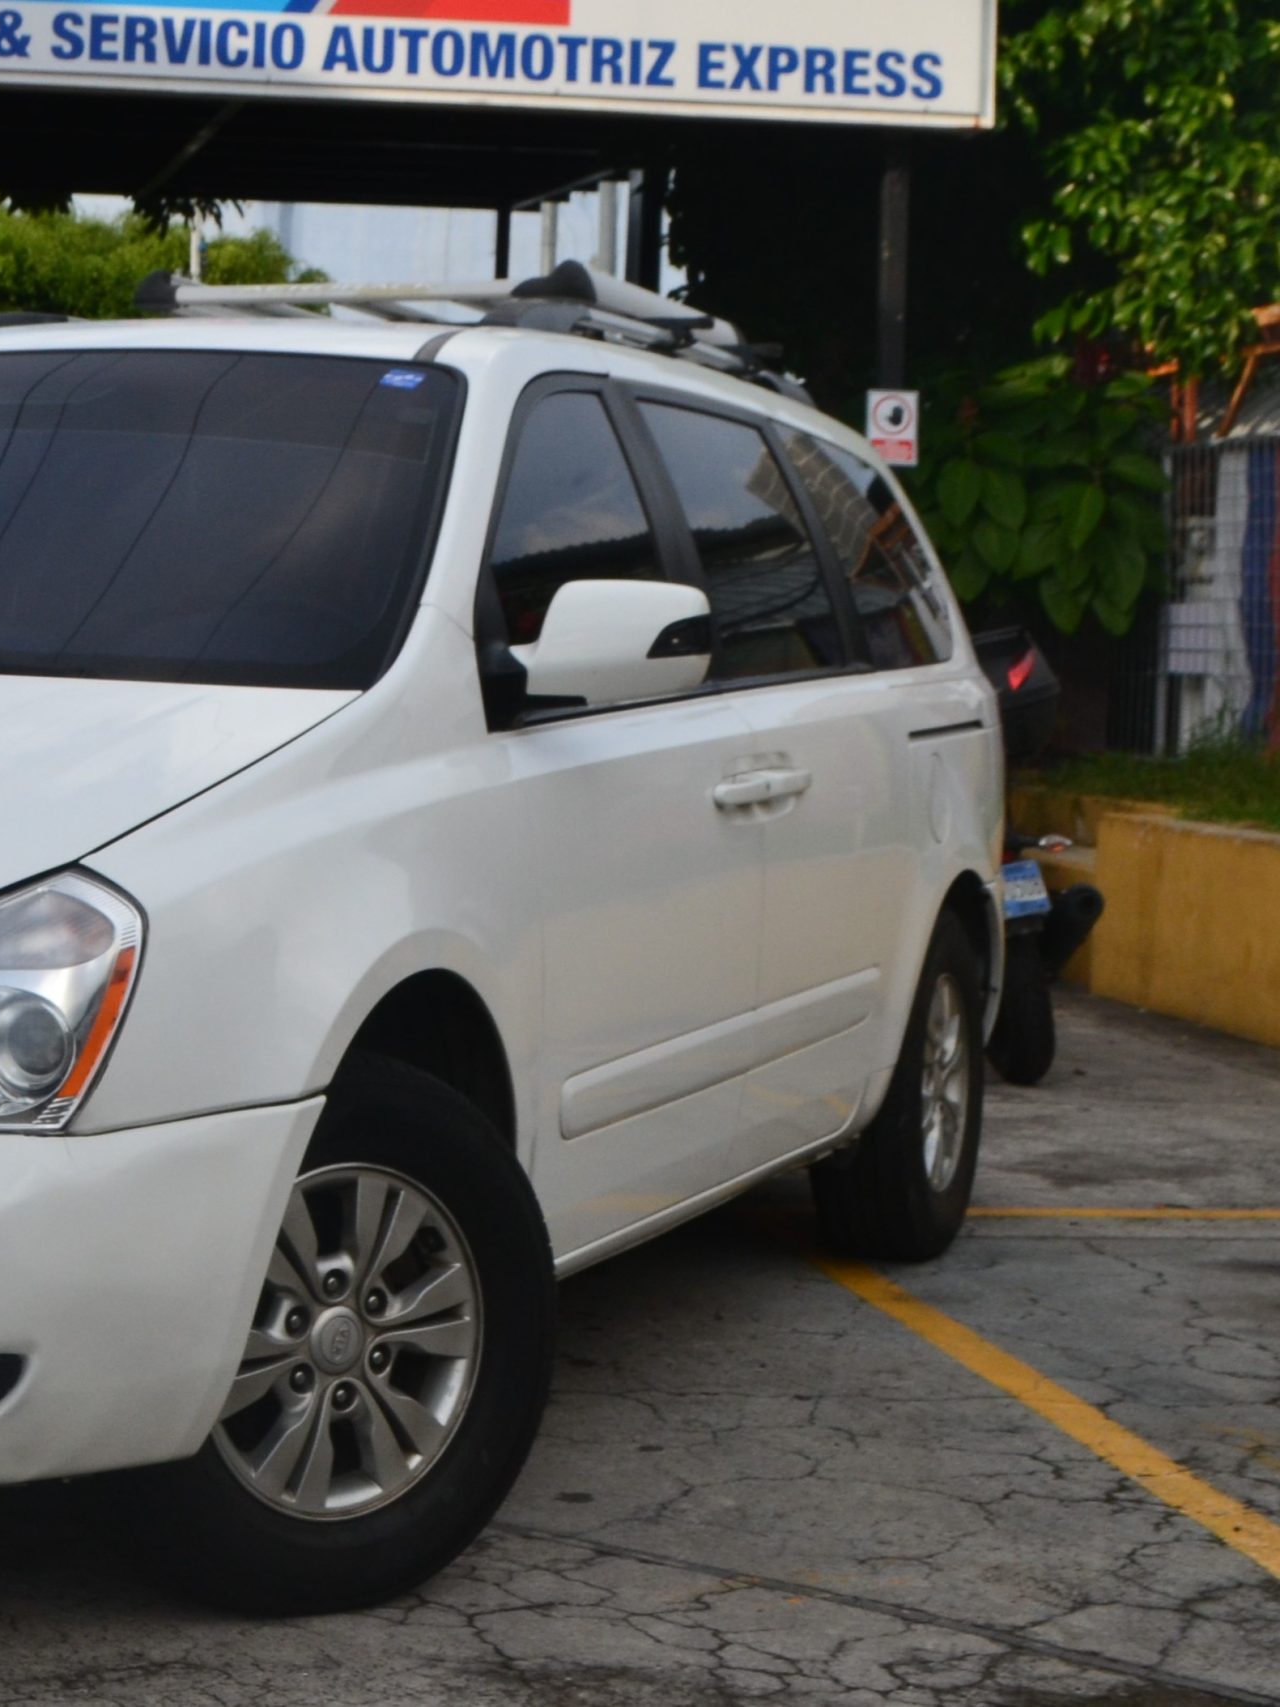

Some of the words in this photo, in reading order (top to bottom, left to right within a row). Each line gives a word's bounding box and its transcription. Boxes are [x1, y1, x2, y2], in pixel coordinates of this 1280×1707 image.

[51, 11, 305, 70] SERVICIO
[322, 25, 676, 86] AUTOMOTRIZ
[697, 43, 943, 99] EXPRESS
